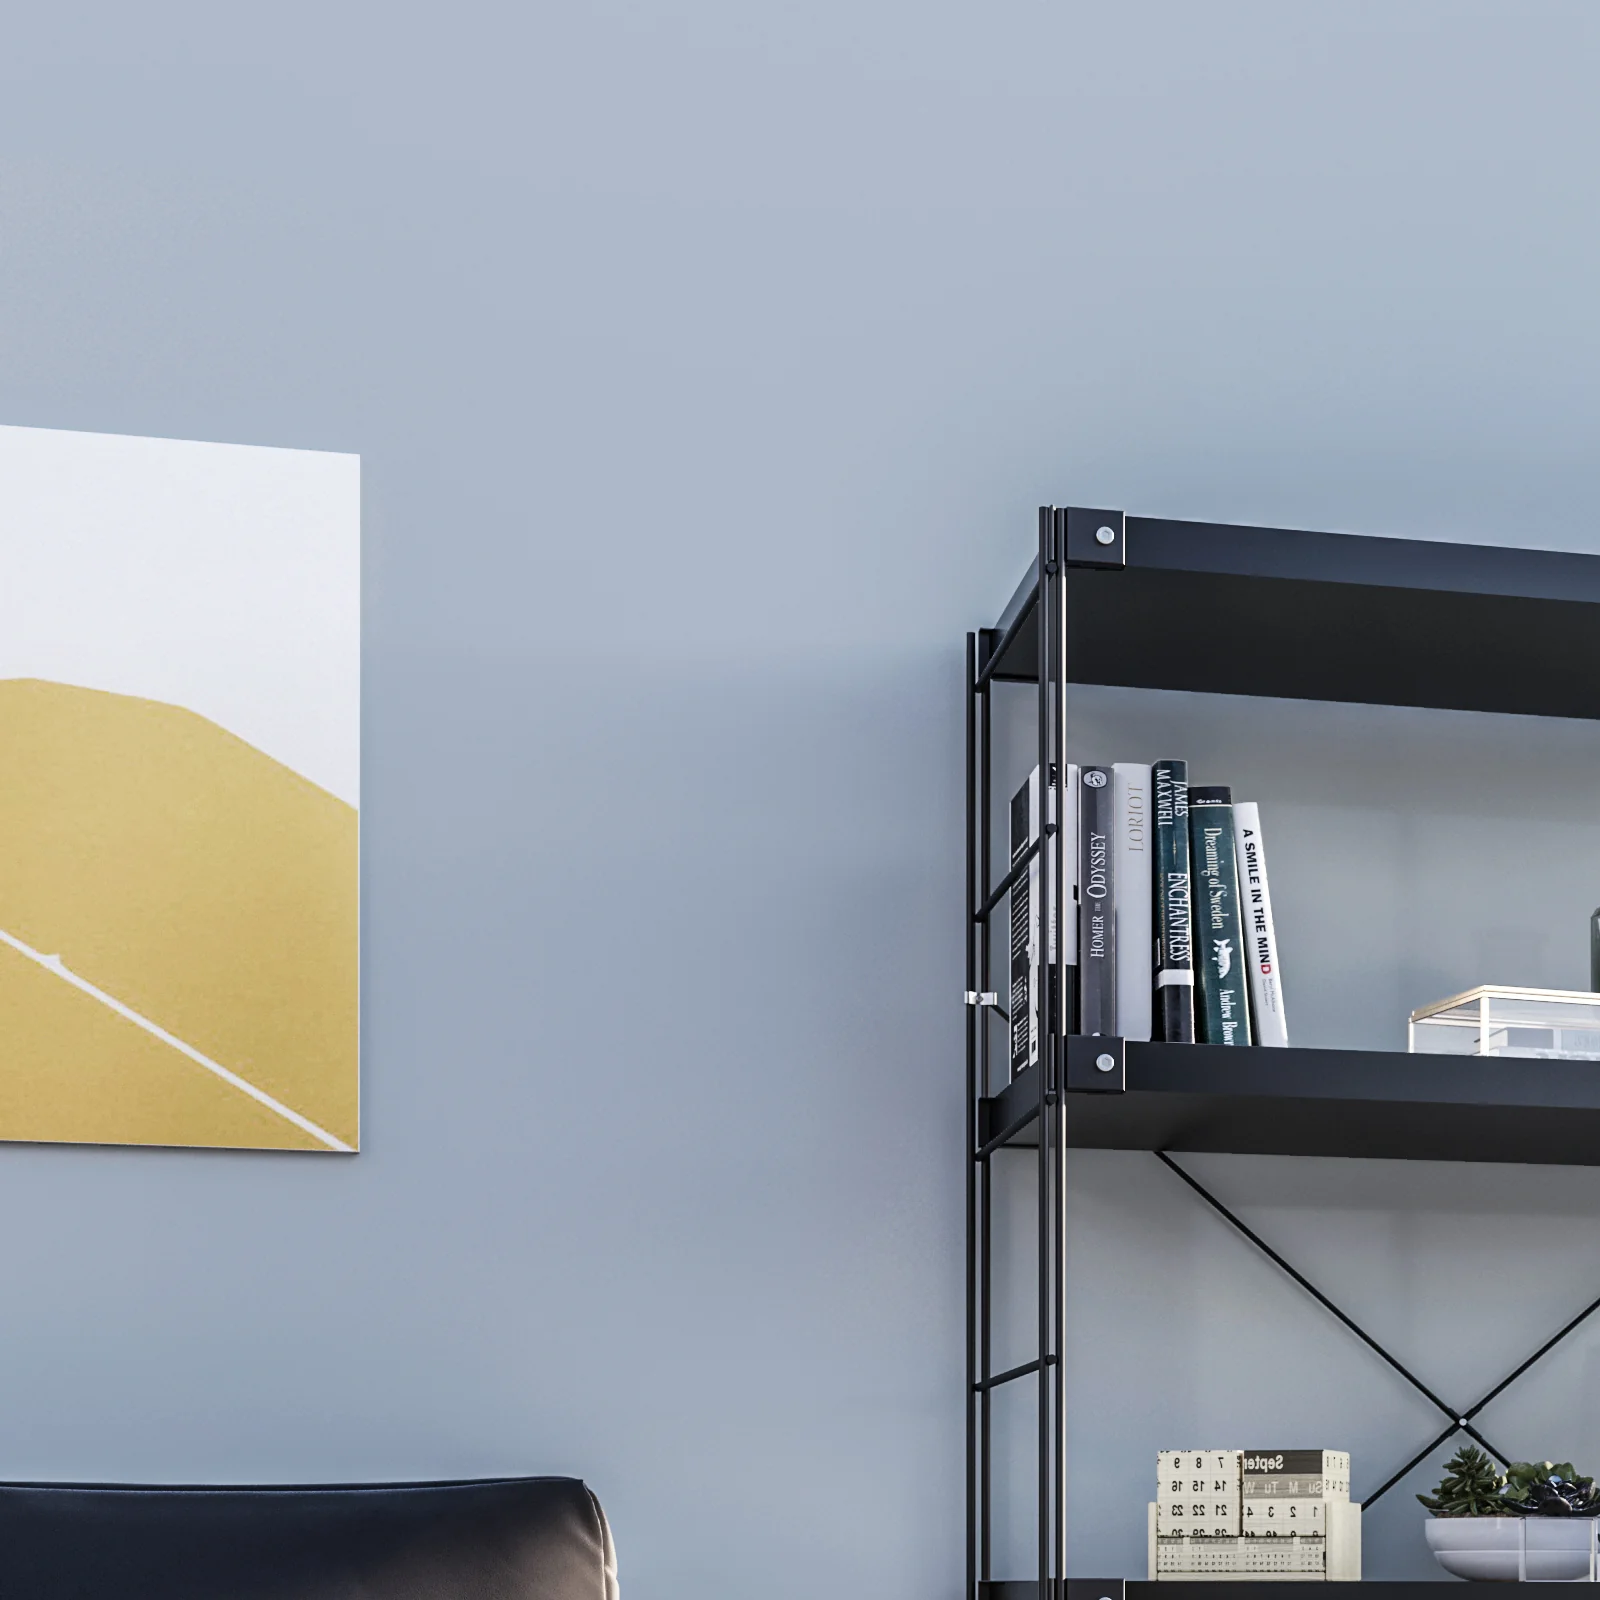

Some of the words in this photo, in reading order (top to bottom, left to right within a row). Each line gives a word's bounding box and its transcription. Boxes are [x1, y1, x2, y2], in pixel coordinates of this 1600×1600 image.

[1128, 783, 1144, 852] LORIOT
[1157, 769, 1174, 829] MAXWELL
[1170, 780, 1189, 818] JAMES
[1200, 827, 1225, 877] Dreaming
[1242, 828, 1253, 839] A
[1086, 832, 1108, 899] ODYSSEY
[1244, 842, 1260, 885] SMILE
[1208, 879, 1228, 890] of
[1251, 888, 1262, 903] IN
[1167, 872, 1190, 962] ENCHANTRESS
[1209, 890, 1230, 929] Sweden
[1253, 907, 1267, 933] THE
[1090, 916, 1105, 958] HOMER
[1257, 937, 1272, 975] MIND
[1219, 988, 1236, 1019] Andrew
